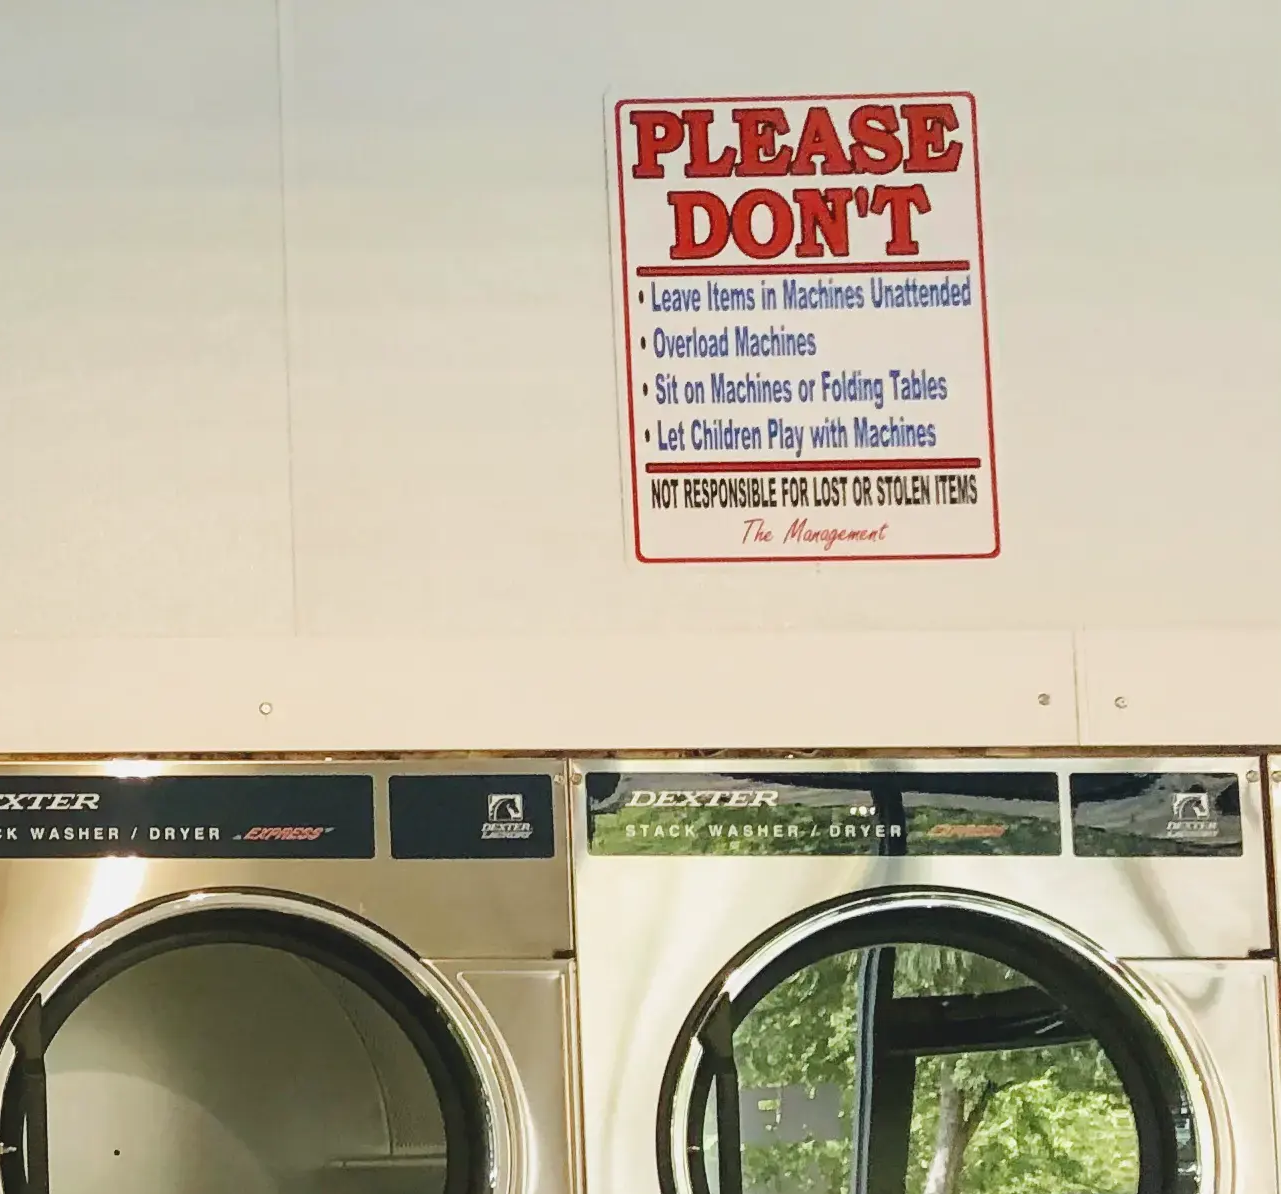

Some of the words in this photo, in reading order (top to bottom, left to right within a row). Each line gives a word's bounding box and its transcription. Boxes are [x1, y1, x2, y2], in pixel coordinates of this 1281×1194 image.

[629, 103, 964, 178] PLEASE
[667, 184, 932, 260] DON'T
[651, 281, 701, 312] Leave
[707, 280, 756, 311] Items
[761, 279, 777, 310] in
[783, 278, 865, 310] Machines
[870, 276, 971, 308] Unattended
[653, 327, 728, 359] Overload
[735, 325, 816, 357] Machines
[655, 373, 679, 404] Sit
[685, 379, 705, 404] on
[711, 371, 792, 403] Machines
[798, 379, 816, 402] or
[822, 370, 884, 409] Folding
[890, 369, 948, 400] Tables
[657, 420, 685, 451] Let
[690, 419, 762, 451] Children
[768, 418, 804, 457] Play
[810, 417, 848, 448] with
[854, 417, 937, 448] Machines
[651, 478, 679, 508] NOT
[684, 478, 778, 508] RESPONSIBLE
[781, 477, 809, 507] FOR
[813, 477, 848, 507] LOST
[852, 476, 873, 506] OR
[877, 475, 930, 506] STOLEN
[935, 474, 978, 505] ITEMS
[740, 518, 773, 545] The
[783, 520, 889, 550] Management
[625, 790, 779, 807] DEXTER
[30, 827, 120, 841] WASHER
[149, 827, 220, 841] DRYER
[481, 822, 531, 832] DEXTER
[625, 824, 697, 838] STACK
[708, 824, 798, 838] WASHER
[829, 824, 902, 838] DRYER
